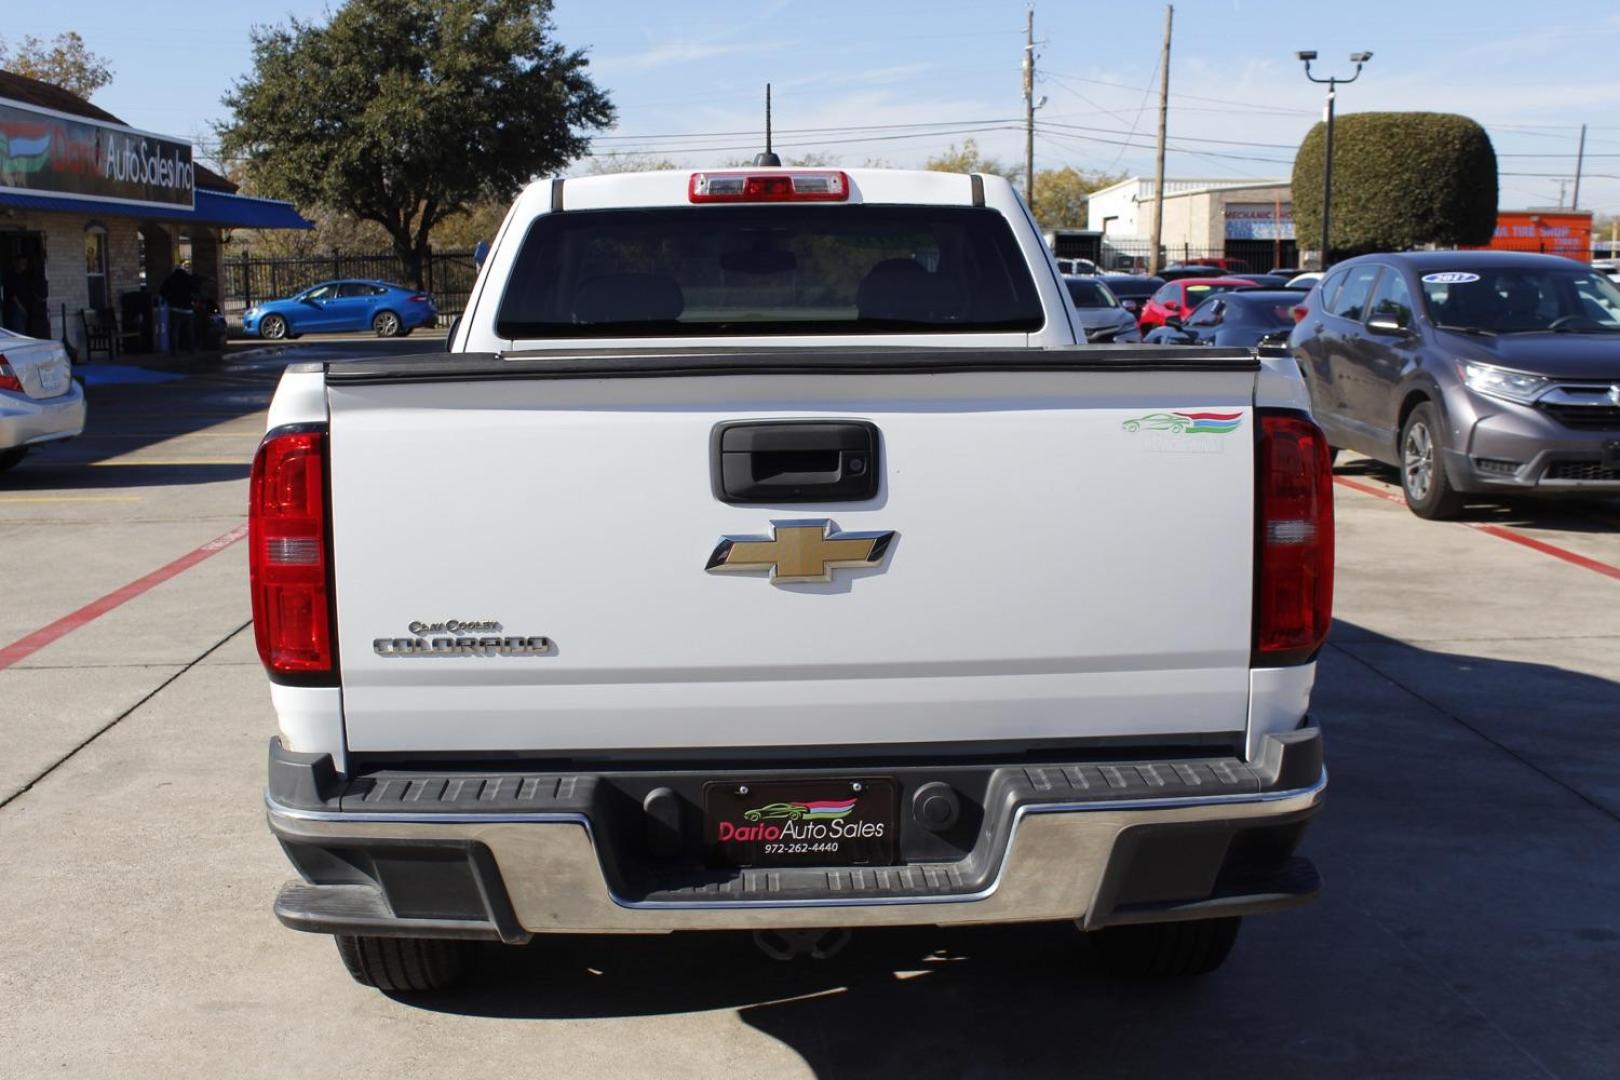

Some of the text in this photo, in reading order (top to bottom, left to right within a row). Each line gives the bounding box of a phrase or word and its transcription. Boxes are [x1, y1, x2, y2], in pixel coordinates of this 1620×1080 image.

[105, 134, 140, 183] Auto
[140, 140, 173, 188] Sales
[175, 149, 192, 190] Inc
[373, 637, 552, 655] COLORADO
[718, 818, 885, 842] Dario Auto Sales
[764, 842, 839, 854] 972-262-4440
